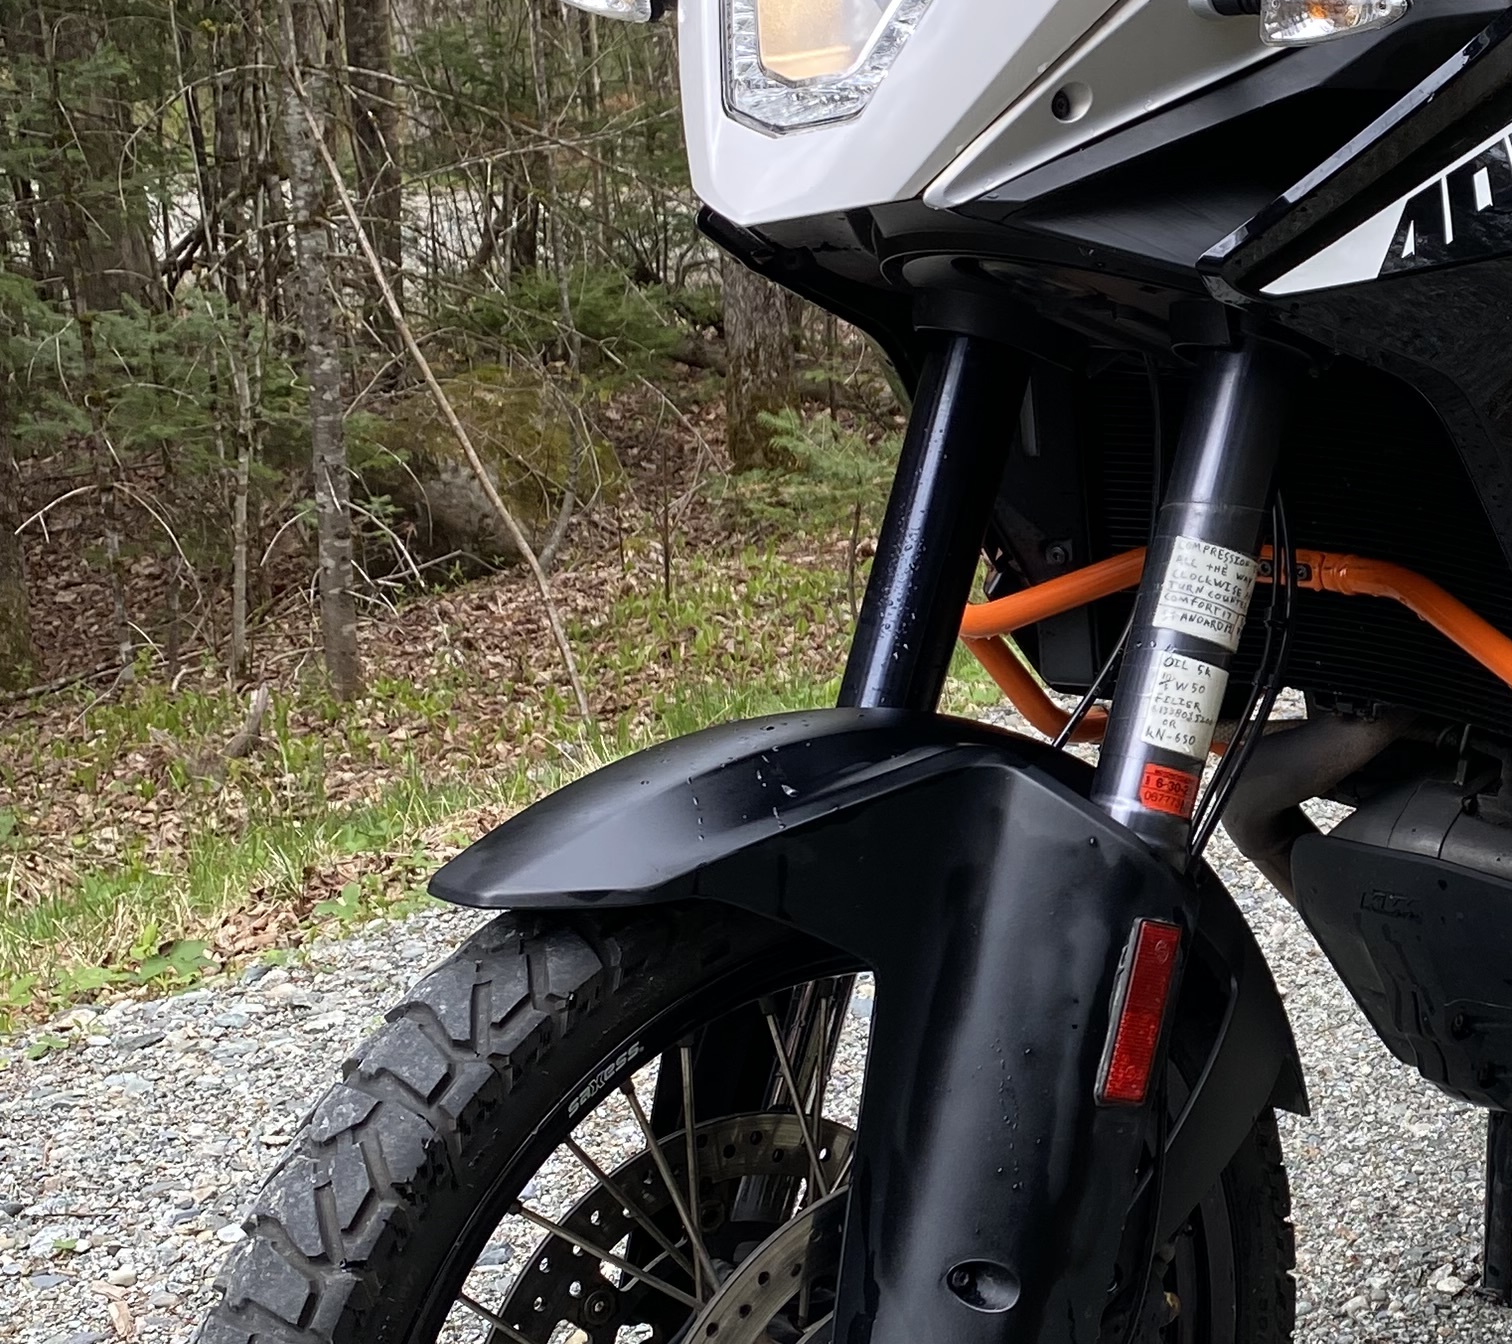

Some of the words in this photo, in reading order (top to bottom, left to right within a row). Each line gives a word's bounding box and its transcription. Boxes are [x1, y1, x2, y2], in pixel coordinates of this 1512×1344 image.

[1168, 580, 1205, 595] TURN
[1164, 592, 1221, 616] COMFORT
[1163, 657, 1189, 671] OIL
[1162, 718, 1177, 730] OR
